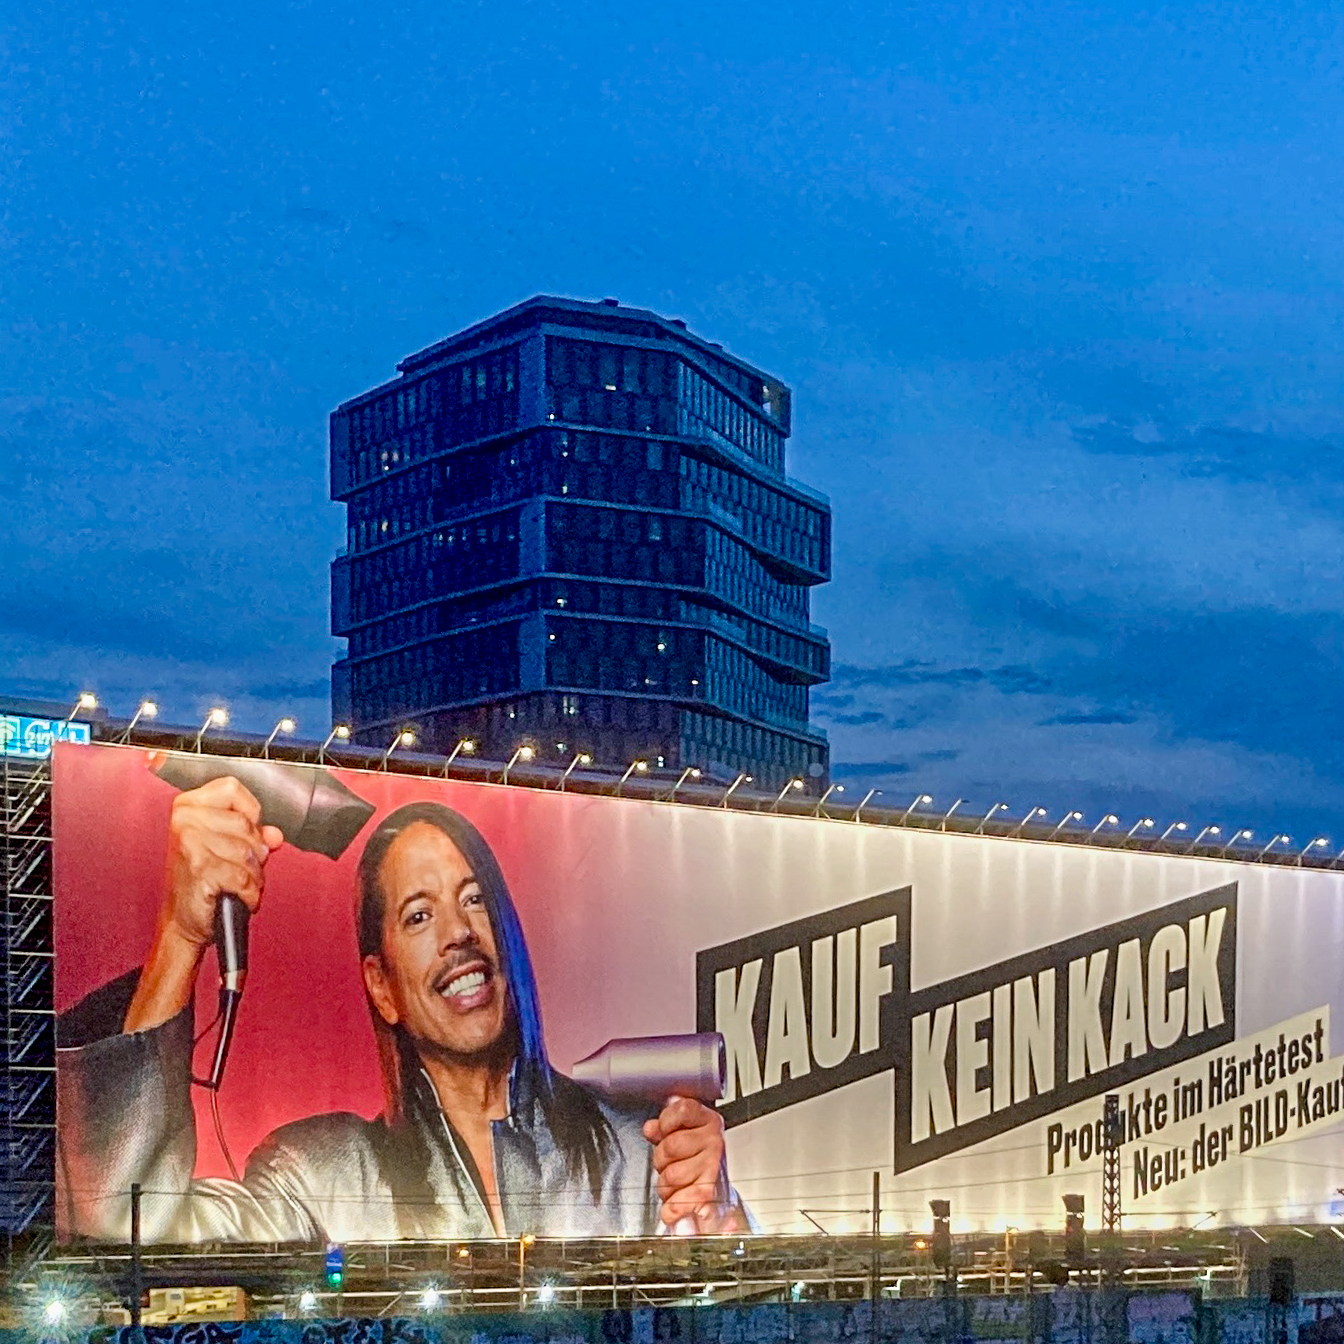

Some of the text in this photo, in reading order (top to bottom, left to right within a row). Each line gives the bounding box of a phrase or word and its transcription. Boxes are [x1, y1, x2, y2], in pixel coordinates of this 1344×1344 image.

[715, 915, 897, 1107] KAUF
[911, 907, 1227, 1145] KEIN KACK
[1173, 1076, 1202, 1123] im
[1208, 1018, 1324, 1109] Härtetest
[1133, 1146, 1186, 1199] Neu:
[1192, 1123, 1233, 1174] der
